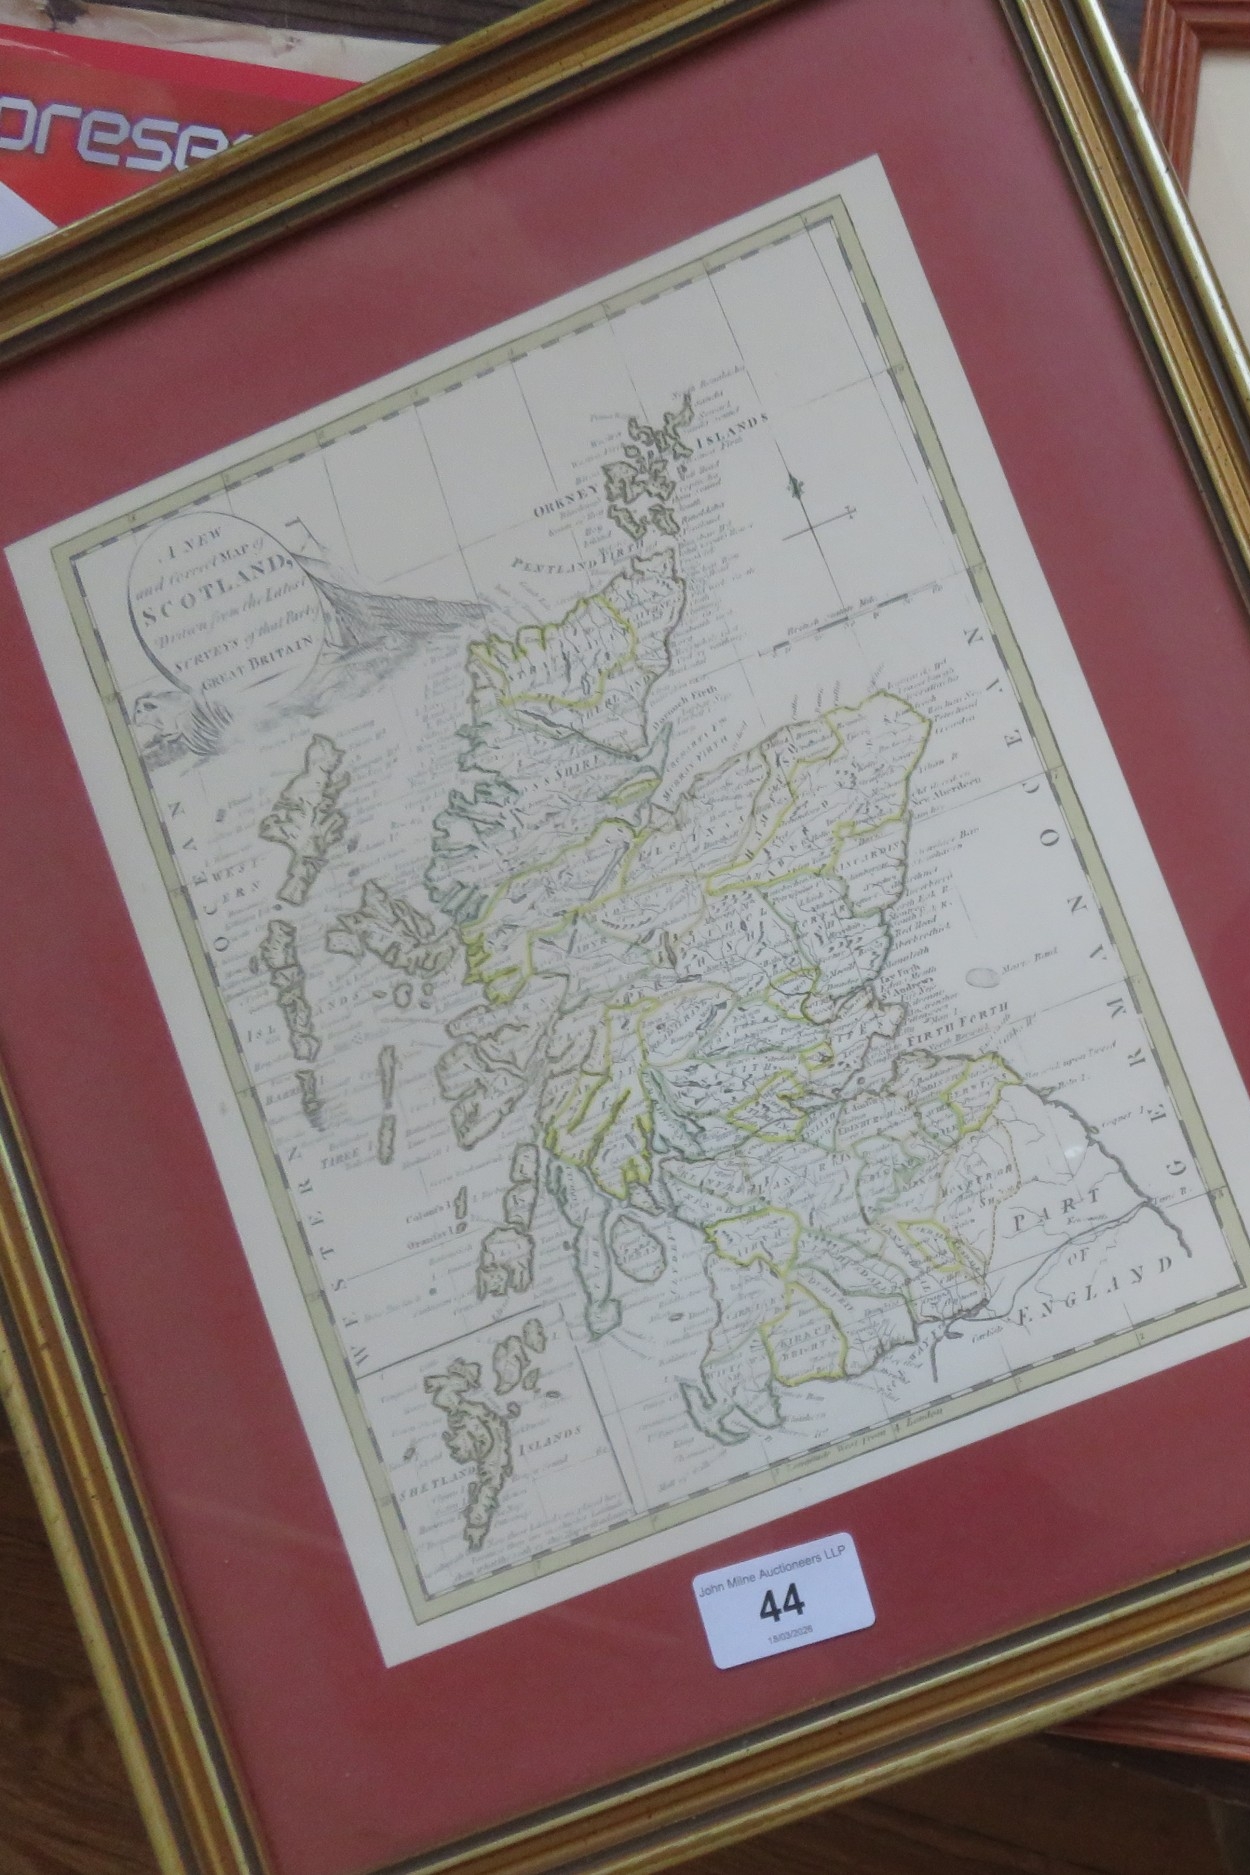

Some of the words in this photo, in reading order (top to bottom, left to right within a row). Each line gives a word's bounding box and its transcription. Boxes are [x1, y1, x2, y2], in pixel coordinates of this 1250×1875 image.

[533, 483, 599, 518] ORKNEY
[695, 412, 768, 448] ISLANDS
[219, 543, 250, 562] MAP
[140, 550, 294, 626] SCOTLAND,
[200, 666, 245, 691] GREAT
[249, 635, 314, 669] BRITAIN
[892, 975, 933, 995] Andrews
[907, 1021, 955, 1047] FIRTH
[1012, 1184, 1102, 1232] PART
[1016, 1251, 1175, 1329] ENGLAND
[516, 1421, 584, 1457] ISLANDS
[698, 1582, 726, 1598] John
[726, 1573, 757, 1590] Milne
[758, 1553, 823, 1580] Auctioneers
[823, 1544, 847, 1561] LLP
[759, 1582, 806, 1623] 44
